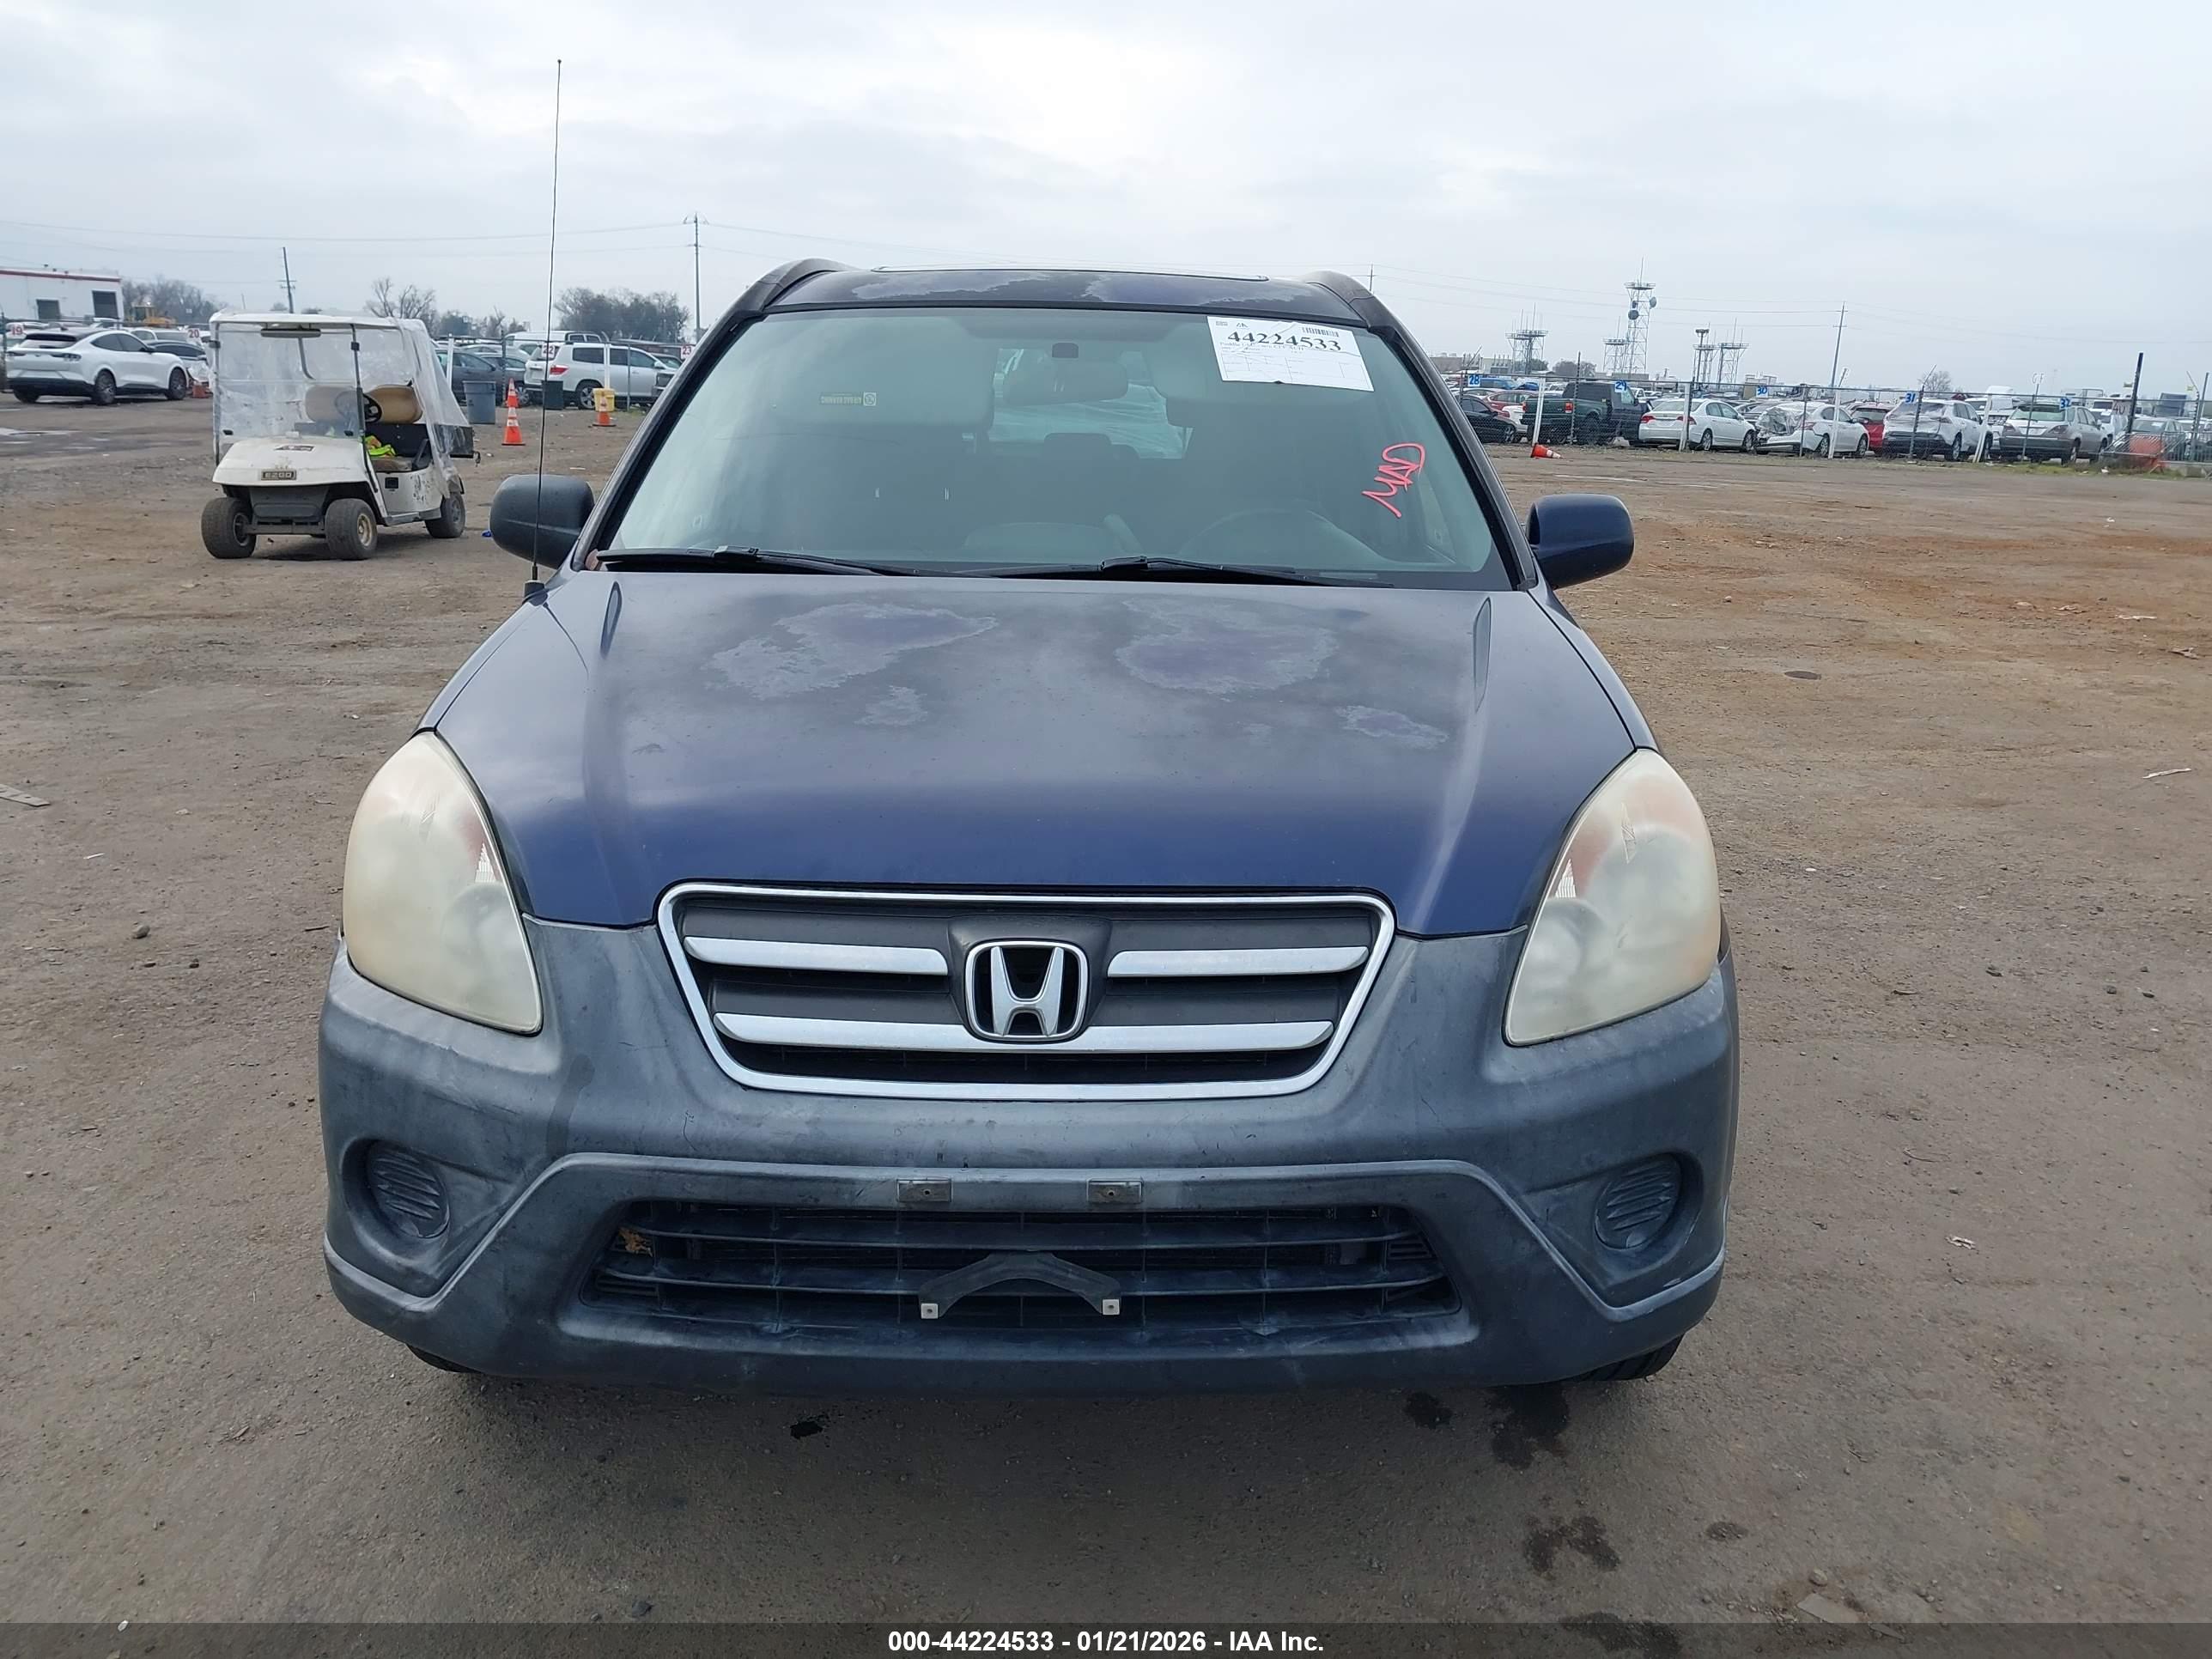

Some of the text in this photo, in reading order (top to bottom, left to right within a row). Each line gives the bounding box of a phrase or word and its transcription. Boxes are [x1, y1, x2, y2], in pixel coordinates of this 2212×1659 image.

[188, 329, 200, 338] 20
[1228, 331, 1342, 351] 44224533
[1469, 374, 1480, 385] 28
[1905, 392, 1916, 403] 31
